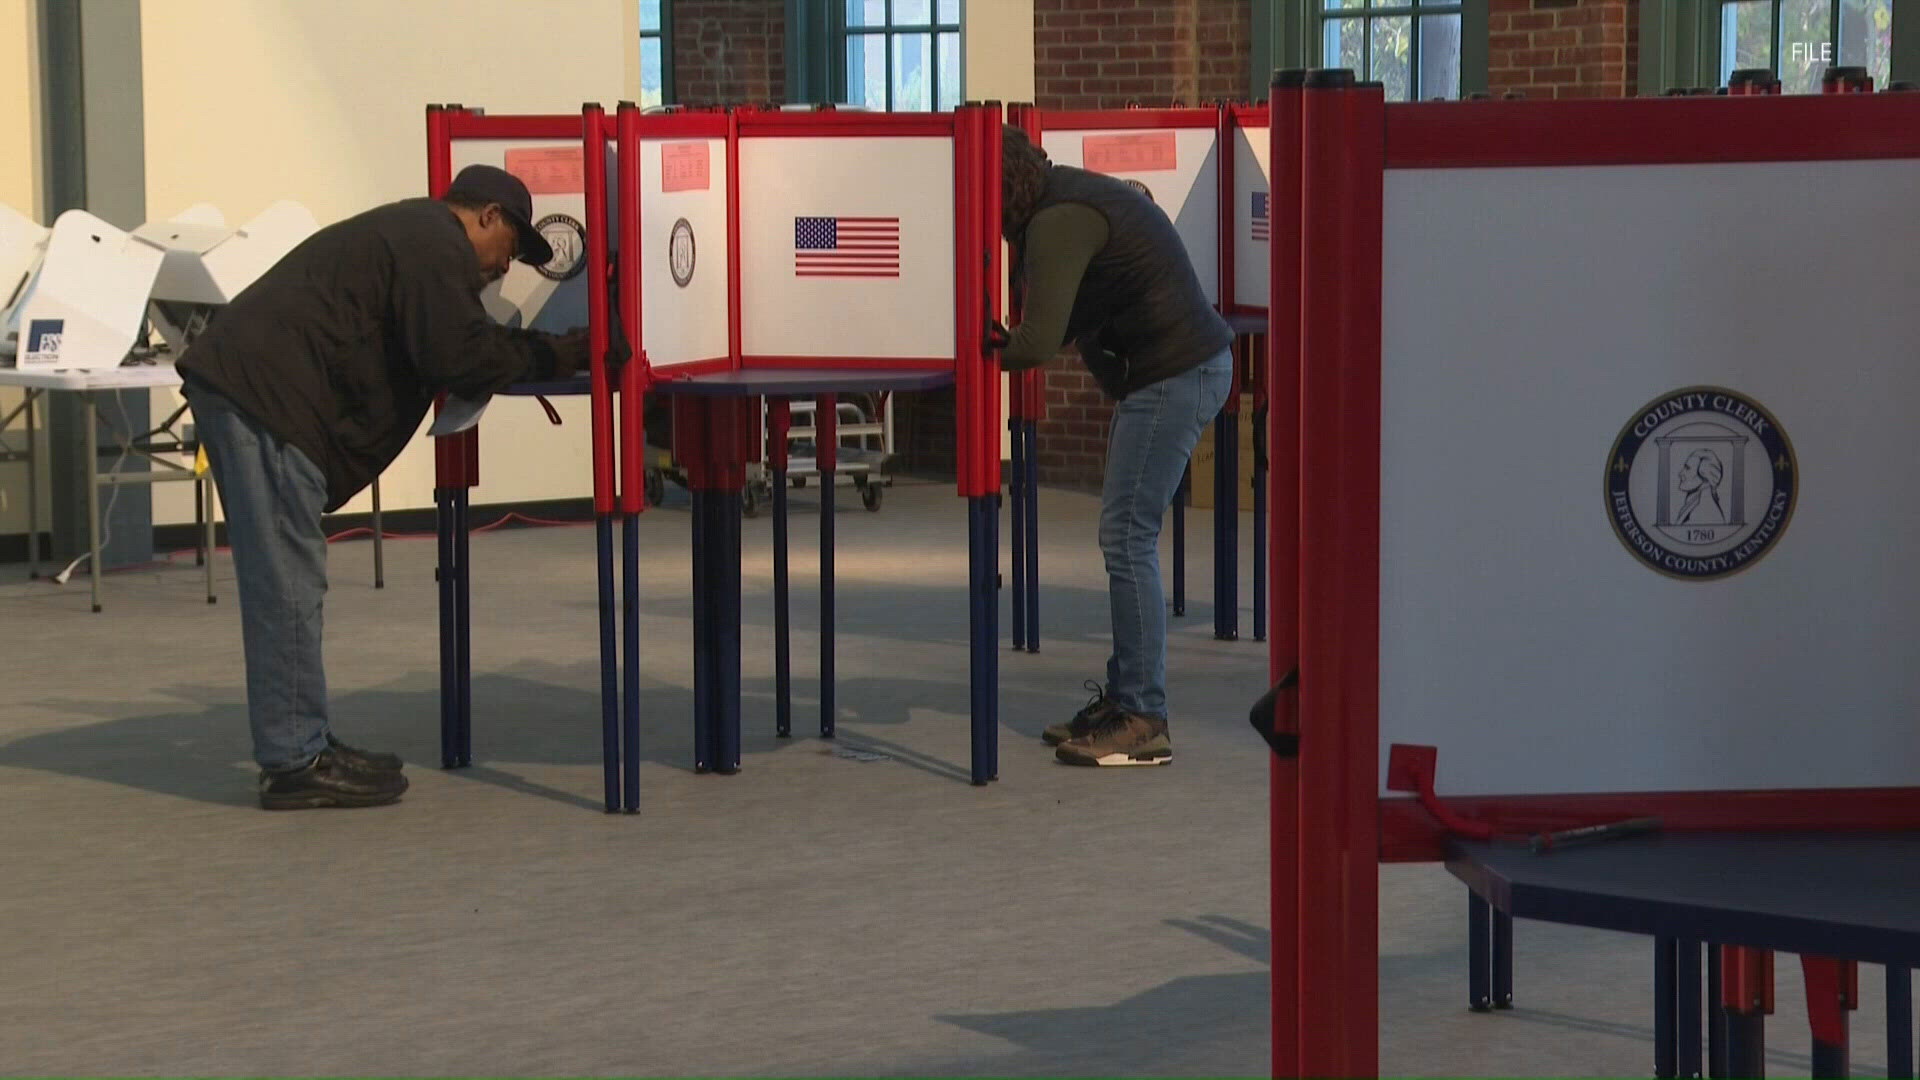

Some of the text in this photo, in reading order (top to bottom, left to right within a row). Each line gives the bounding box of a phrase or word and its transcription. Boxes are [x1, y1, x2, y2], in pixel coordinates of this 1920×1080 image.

[1633, 393, 1769, 438] COUNTY CLERK
[1612, 489, 1788, 573] JEFFERSON COUNTY, KENTUCKY
[1686, 529, 1715, 541] 1780
